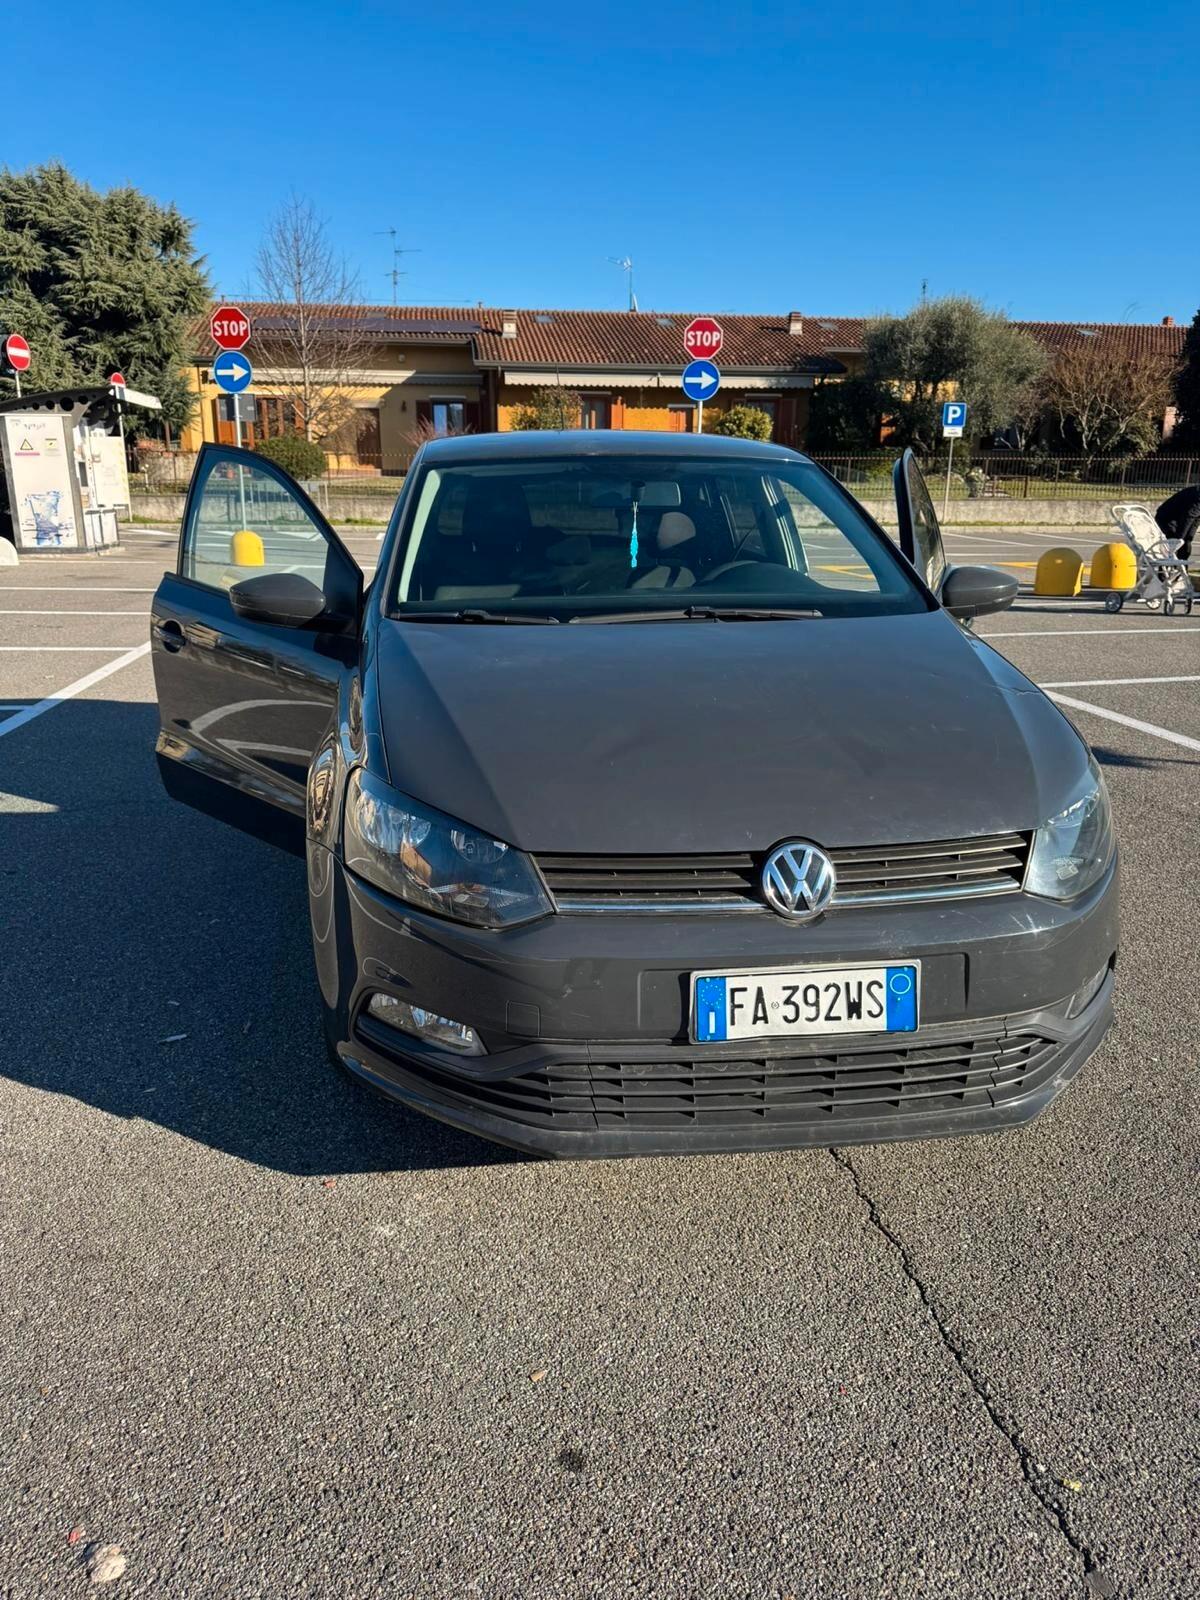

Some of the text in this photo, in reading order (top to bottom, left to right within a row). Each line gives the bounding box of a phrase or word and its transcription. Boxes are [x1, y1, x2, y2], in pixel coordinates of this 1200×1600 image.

[213, 320, 247, 337] STOP
[687, 331, 720, 347] STOP
[947, 405, 961, 424] P
[766, 846, 833, 915] VW
[708, 1011, 716, 1034] I
